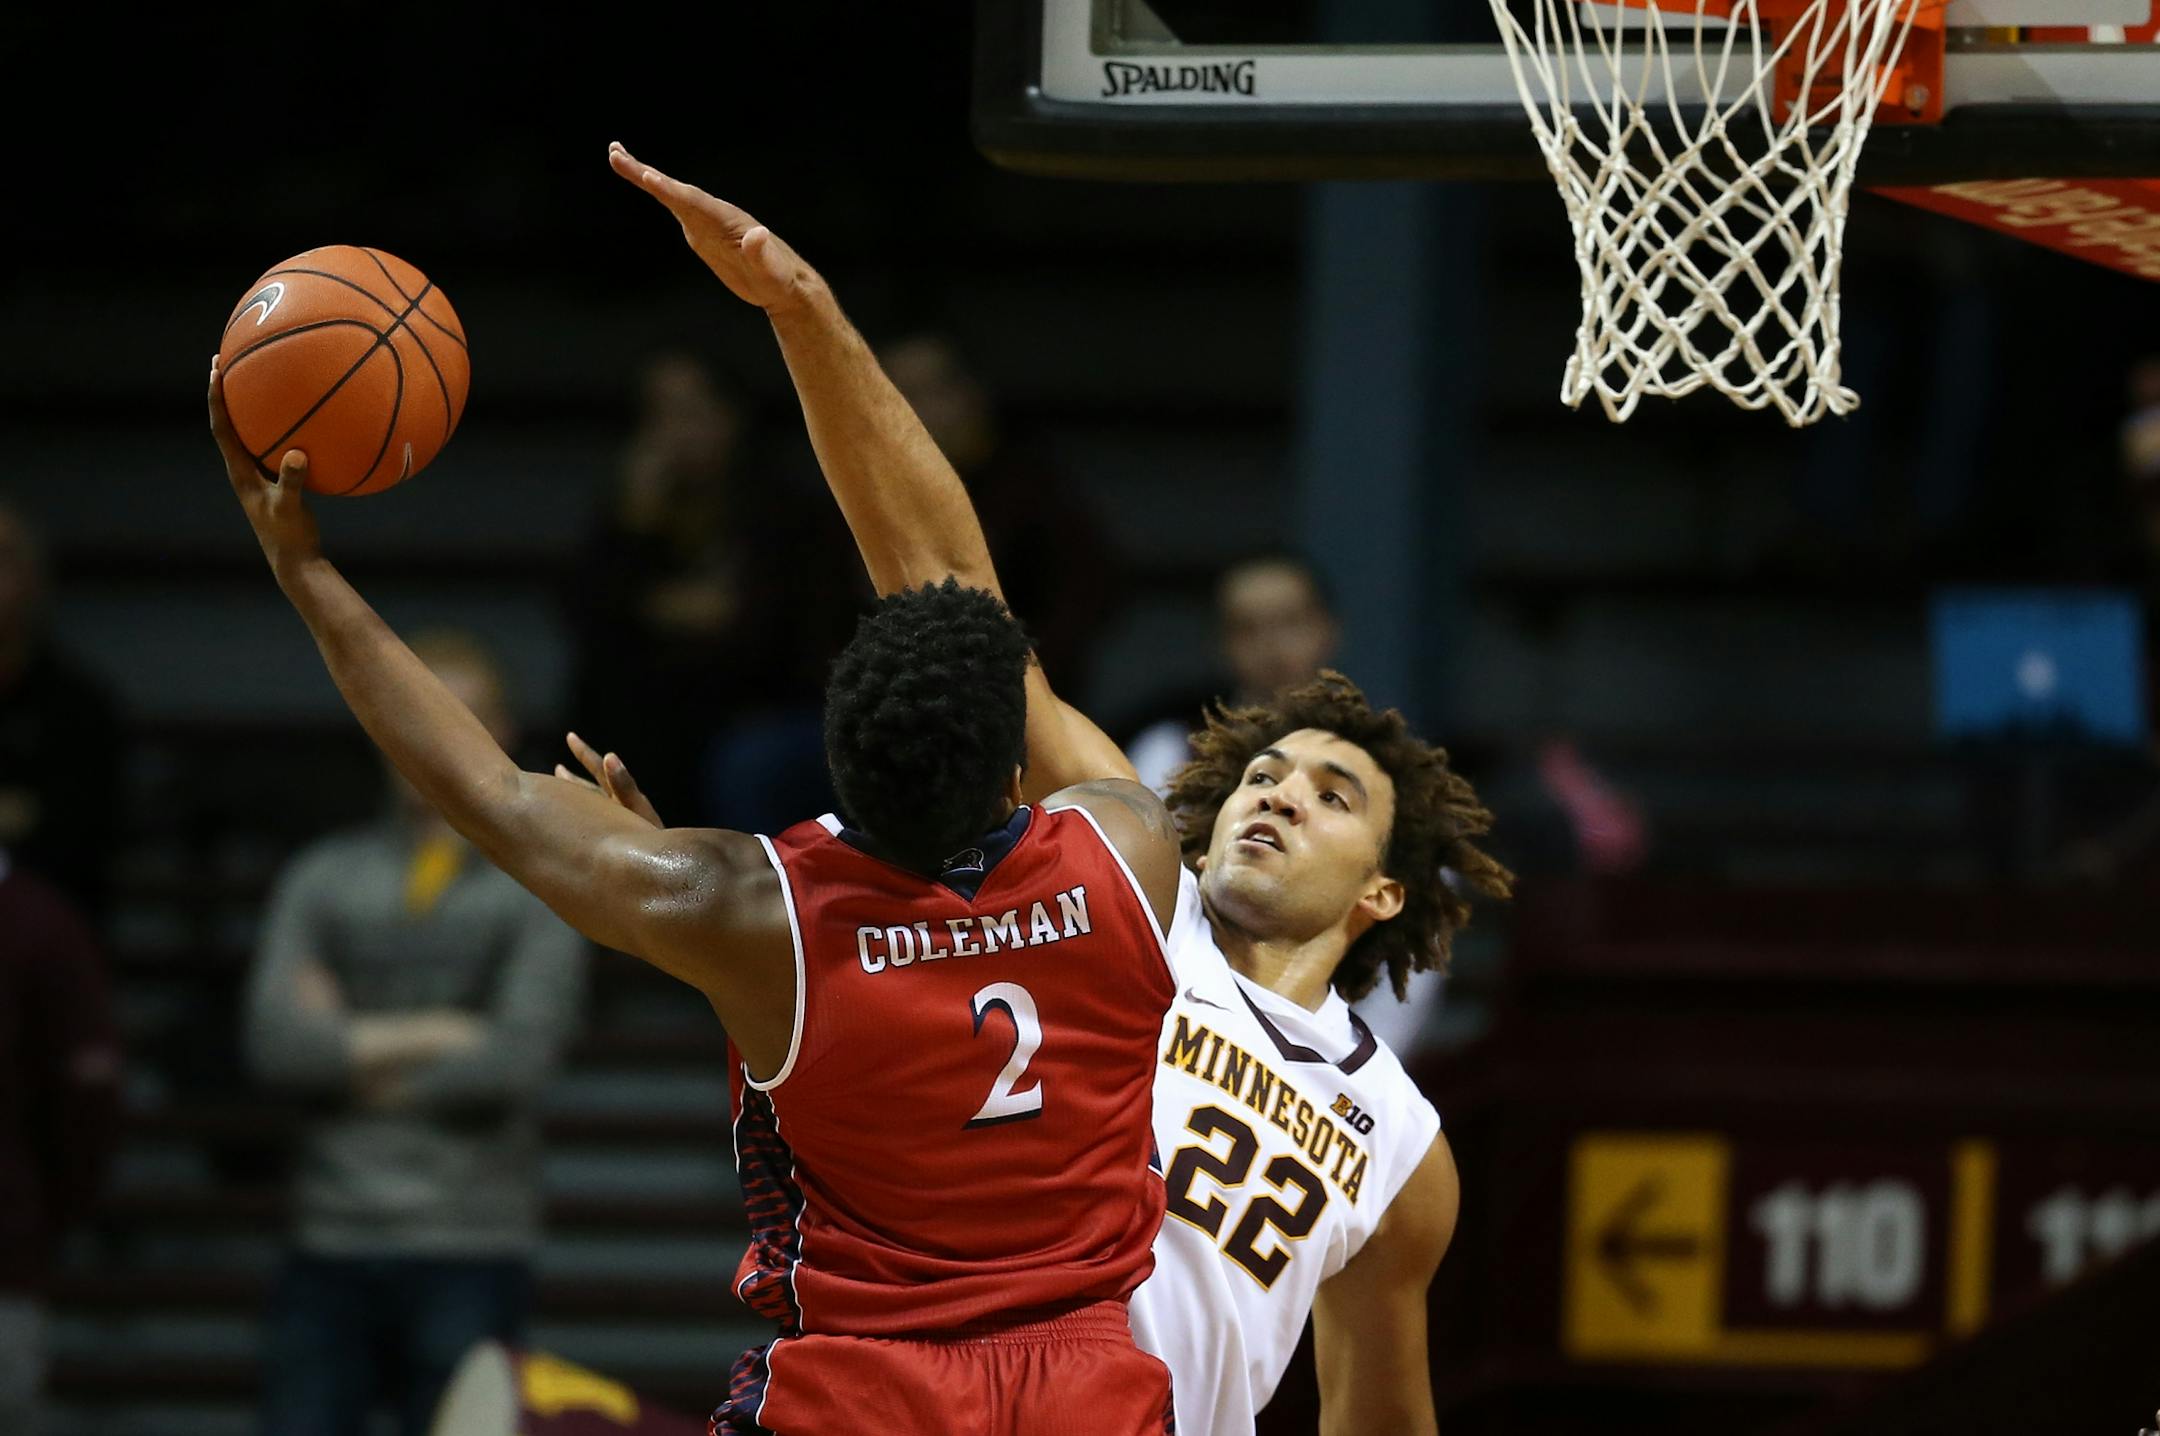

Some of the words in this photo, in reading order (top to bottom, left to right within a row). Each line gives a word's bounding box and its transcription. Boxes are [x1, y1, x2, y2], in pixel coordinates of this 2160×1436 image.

[1102, 61, 1255, 96] SPALDING
[857, 886, 1093, 974] COLEMAN
[963, 981, 1043, 1131] 2
[1163, 1014, 1368, 1207] MINNESOTA
[1167, 1104, 1329, 1292] 22
[1751, 1179, 1926, 1310] 110
